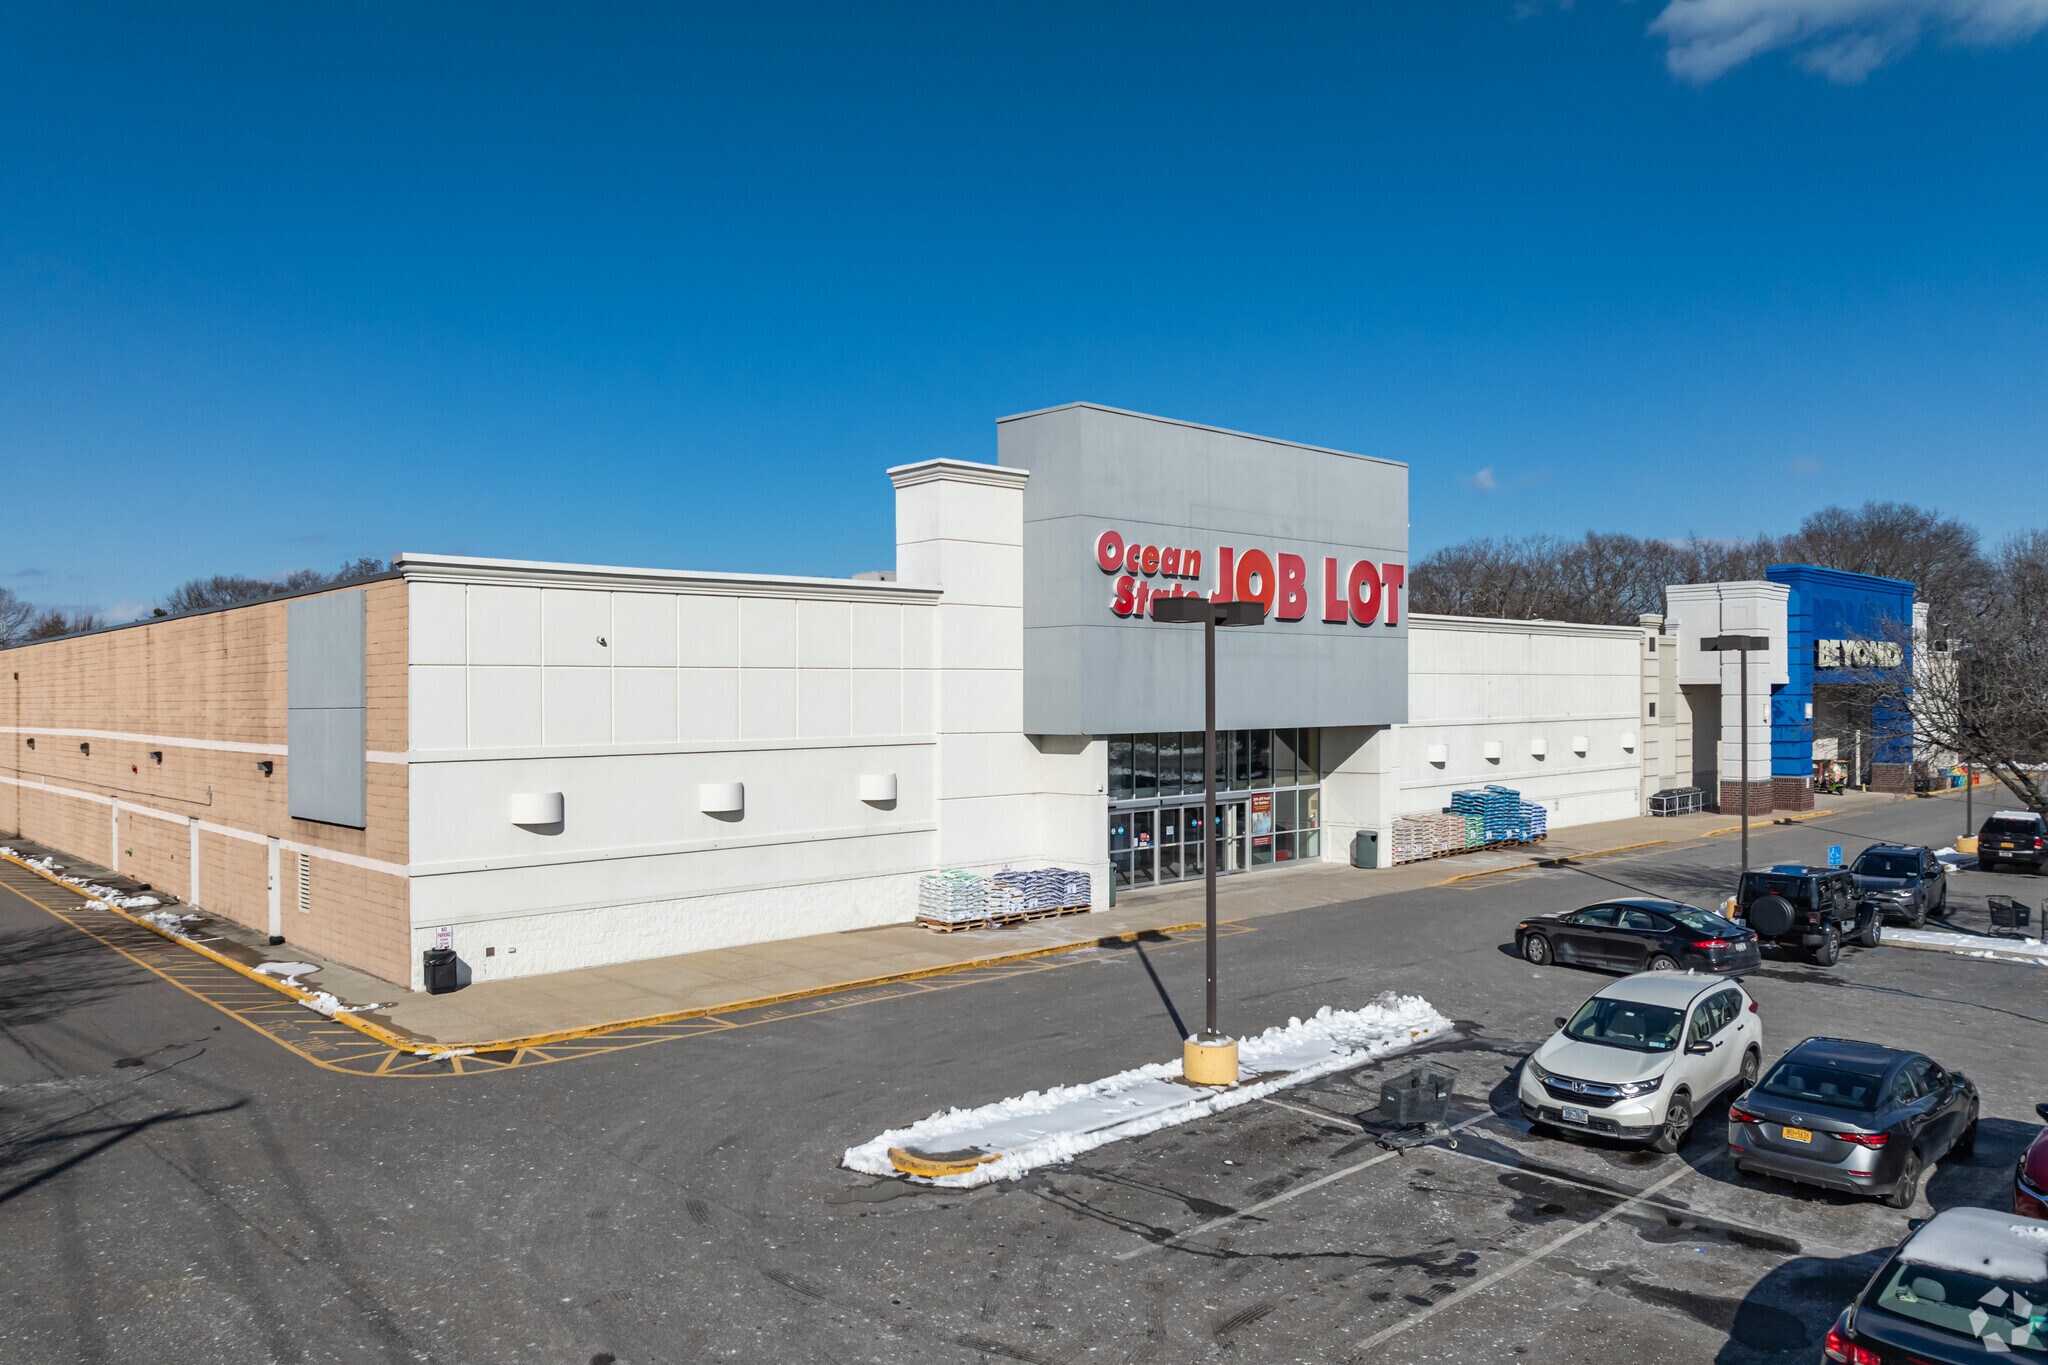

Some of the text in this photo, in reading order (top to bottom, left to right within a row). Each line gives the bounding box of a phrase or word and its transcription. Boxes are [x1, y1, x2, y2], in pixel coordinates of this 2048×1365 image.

[1095, 530, 1202, 575] Ocean
[1110, 575, 1201, 617] Sta
[1208, 546, 1405, 625] JOB LOT
[1818, 639, 1904, 668] BEYOND
